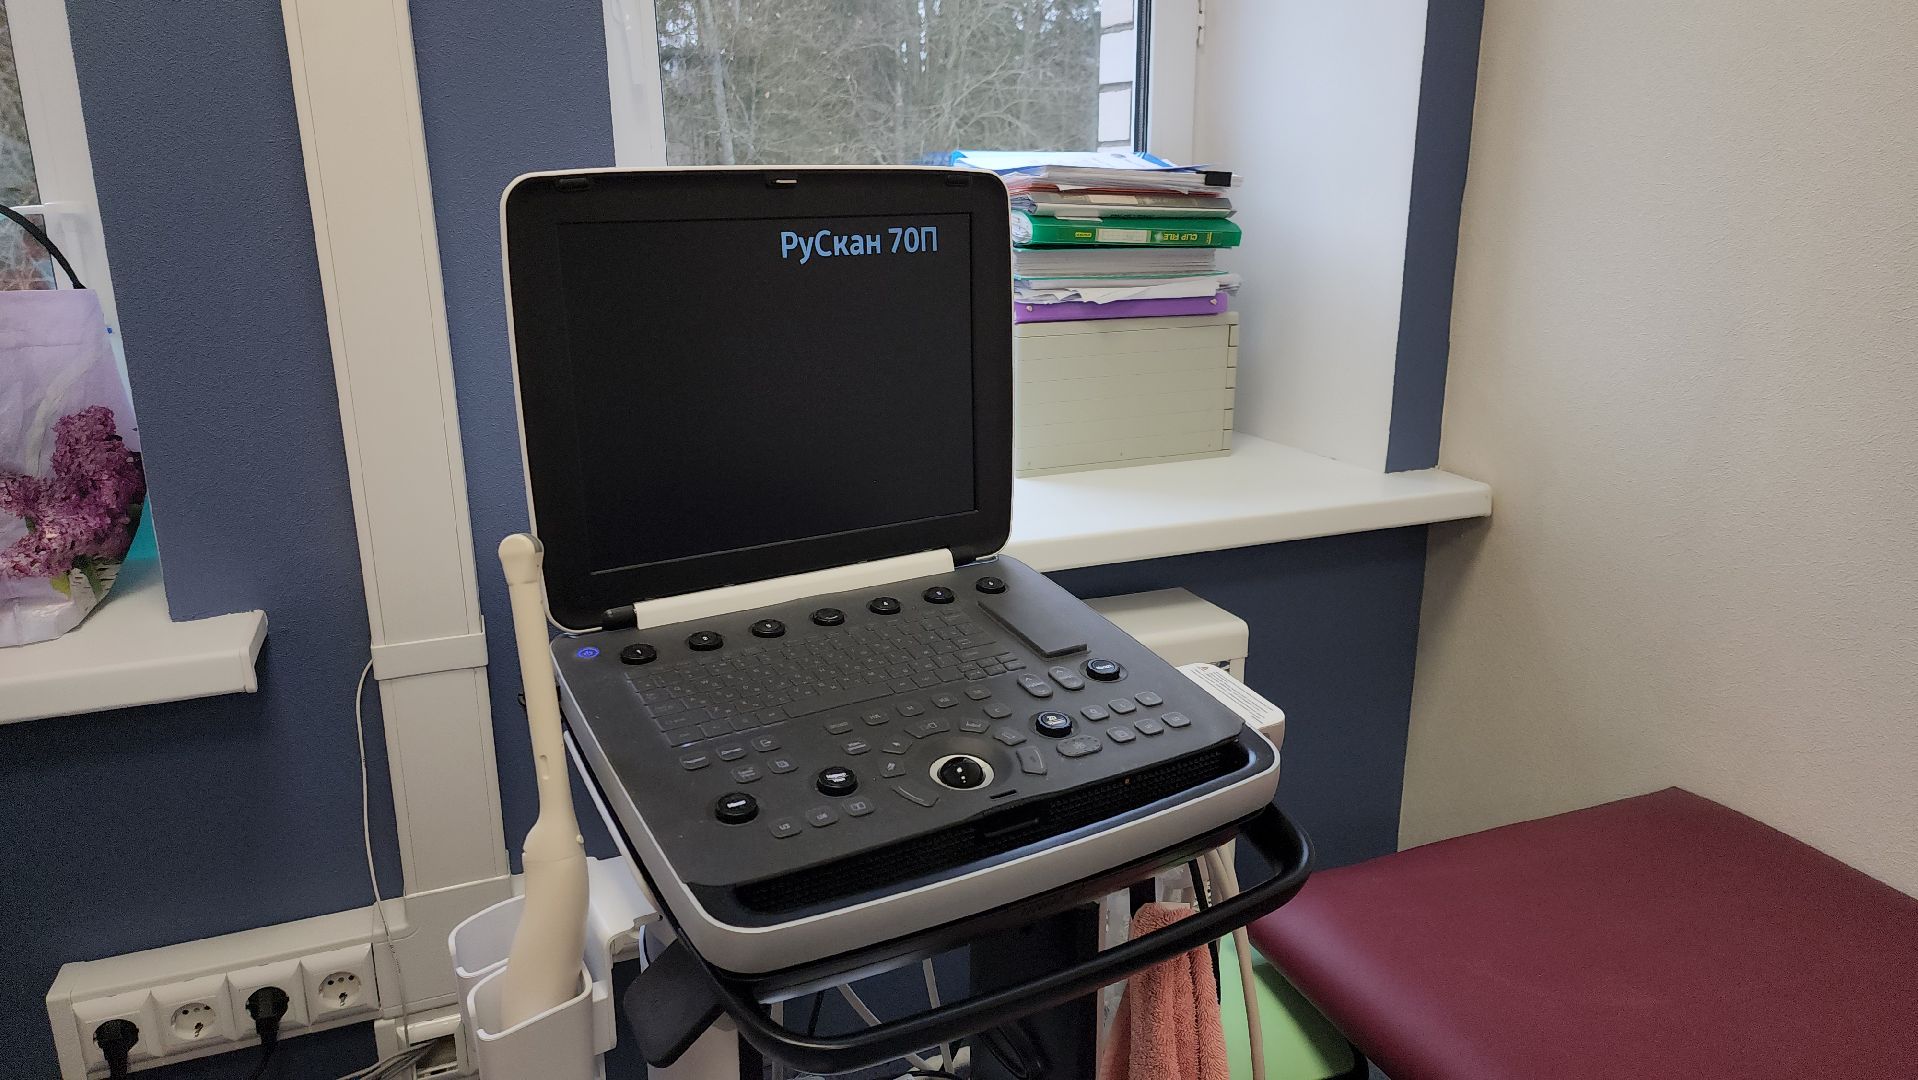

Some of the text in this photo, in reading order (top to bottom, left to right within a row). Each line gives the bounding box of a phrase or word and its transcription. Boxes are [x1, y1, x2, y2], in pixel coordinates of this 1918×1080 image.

[780, 226, 938, 265] РуСкан 70П
[1181, 232, 1198, 241] CLIP
